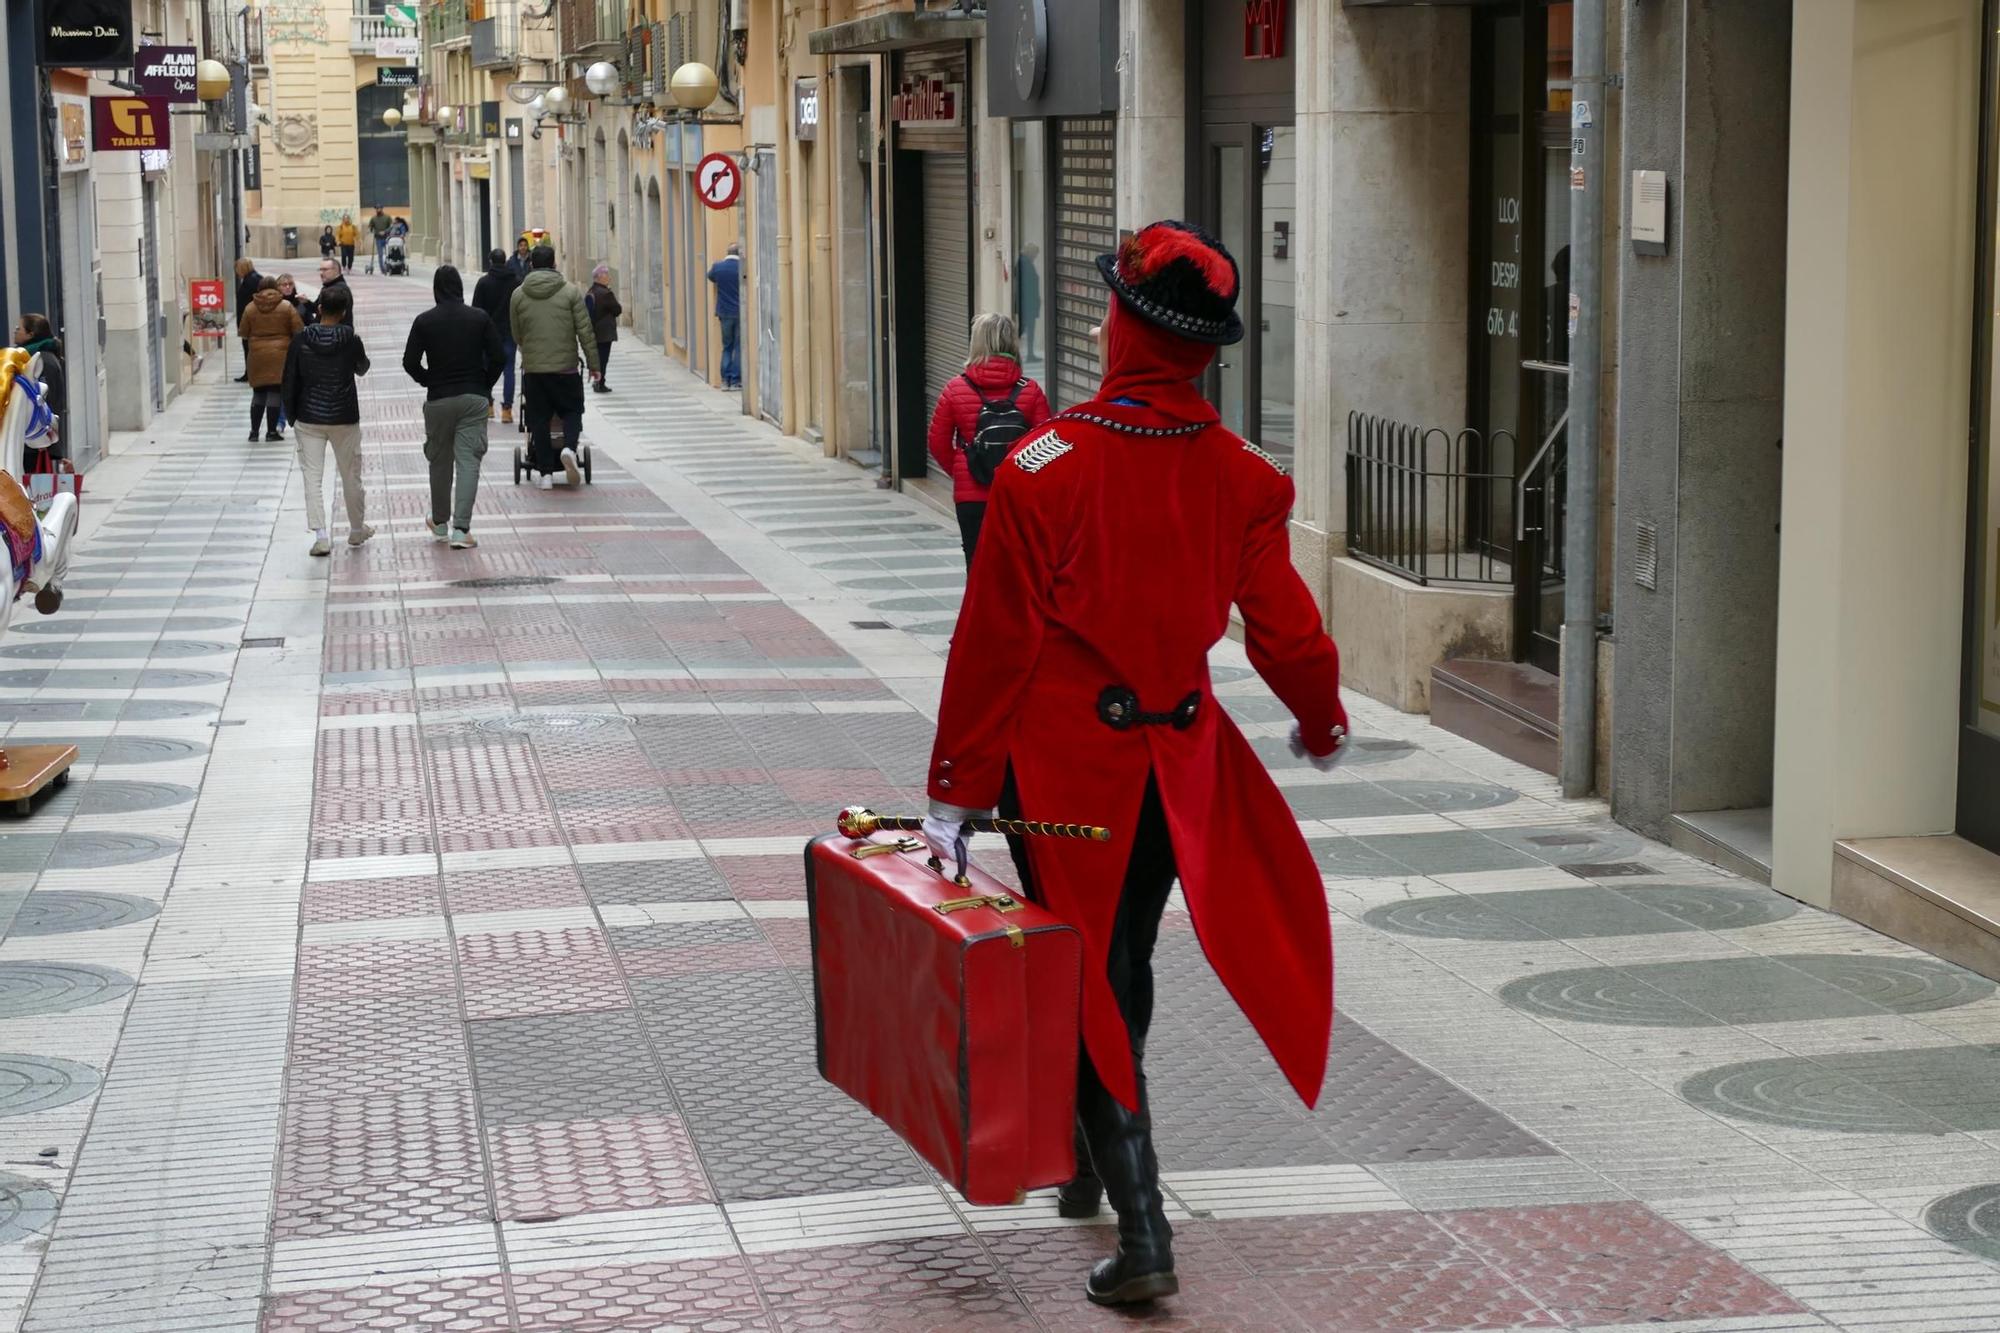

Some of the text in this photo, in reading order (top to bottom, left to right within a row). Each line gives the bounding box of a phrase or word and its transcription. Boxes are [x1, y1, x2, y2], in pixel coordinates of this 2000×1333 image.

[51, 26, 119, 38] Massimo Dutti
[162, 53, 195, 65] ALAIN
[144, 65, 196, 77] AFFLELOU
[111, 137, 156, 147] TABACS
[1487, 307, 1504, 336] 676
